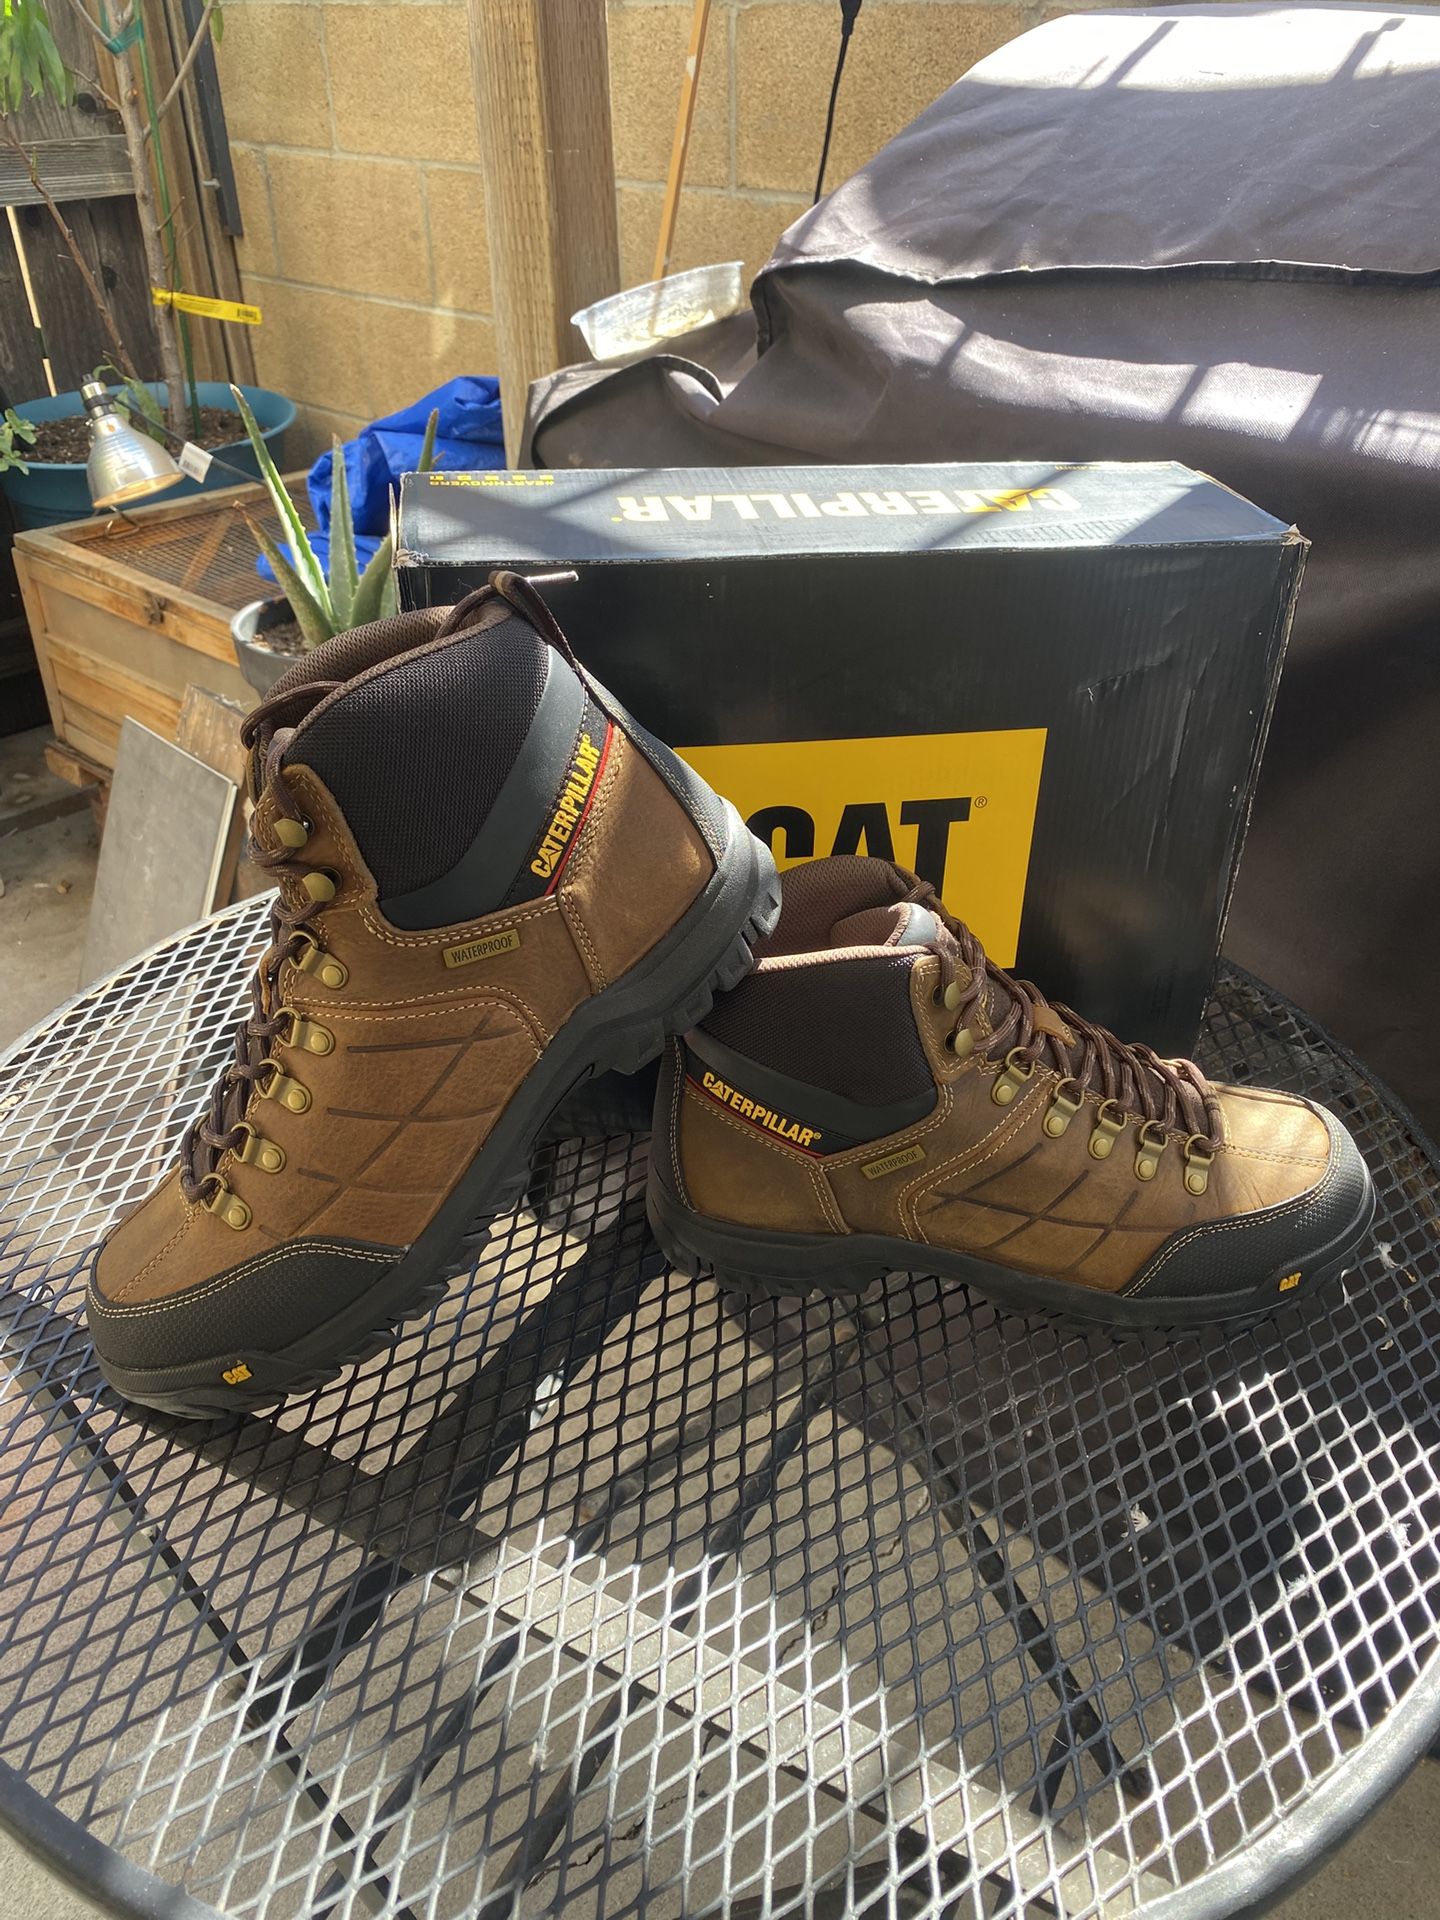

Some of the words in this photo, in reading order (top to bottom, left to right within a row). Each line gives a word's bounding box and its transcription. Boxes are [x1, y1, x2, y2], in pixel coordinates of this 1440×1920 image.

[612, 487, 1082, 522] CATERPILLAR
[451, 935, 513, 963] WATERPROOF
[868, 1149, 919, 1176] WATERPROOF
